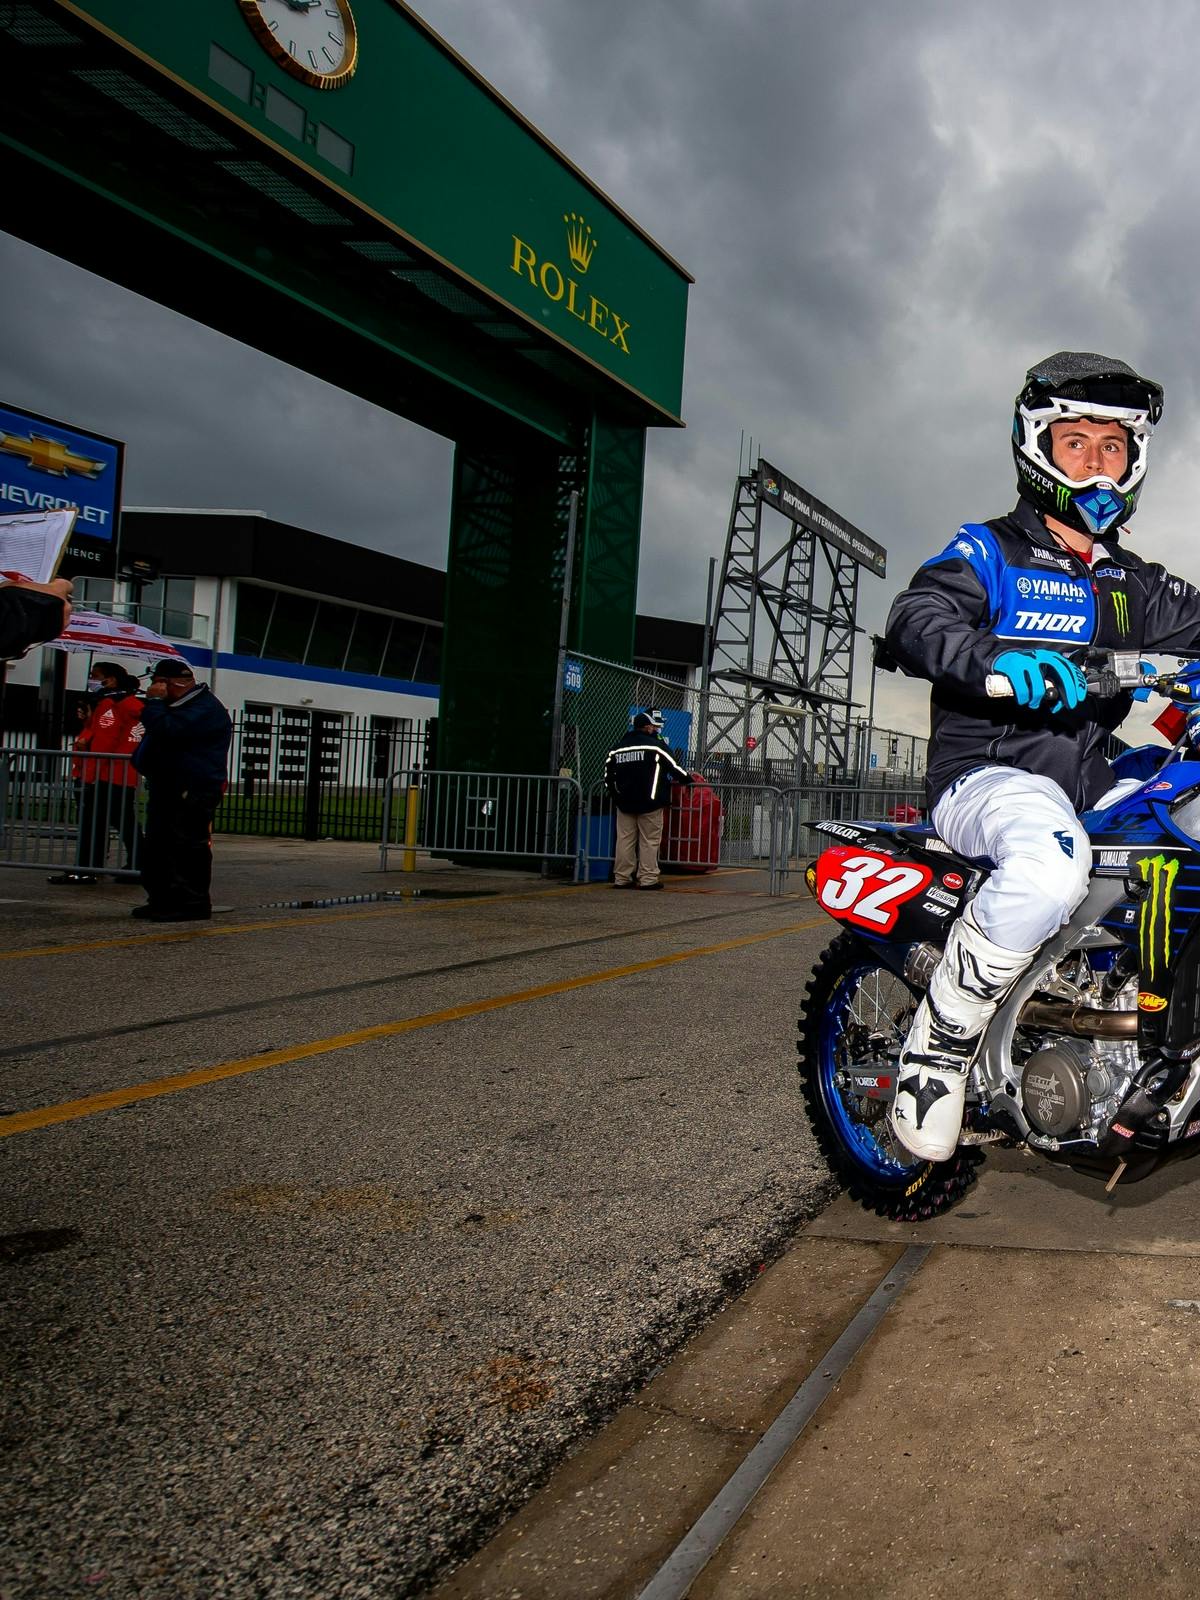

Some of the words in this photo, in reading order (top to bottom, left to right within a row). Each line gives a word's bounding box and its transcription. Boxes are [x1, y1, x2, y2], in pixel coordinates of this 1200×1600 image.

[510, 234, 631, 354] ROLEX
[783, 490, 811, 517] DAYTONA
[811, 510, 851, 545] INTERNATIONAL
[851, 538, 875, 560] SPEEDWAY
[1032, 579, 1087, 598] YAMAHA
[1021, 593, 1084, 604] RACING
[1014, 610, 1087, 634] THOR
[616, 751, 645, 763] SECURITY
[816, 821, 861, 840] DUNLOP
[1100, 851, 1131, 866] YAMALUBE
[821, 856, 924, 925] 32
[1137, 995, 1166, 1008] FMF
[855, 1075, 879, 1088] VORTEX
